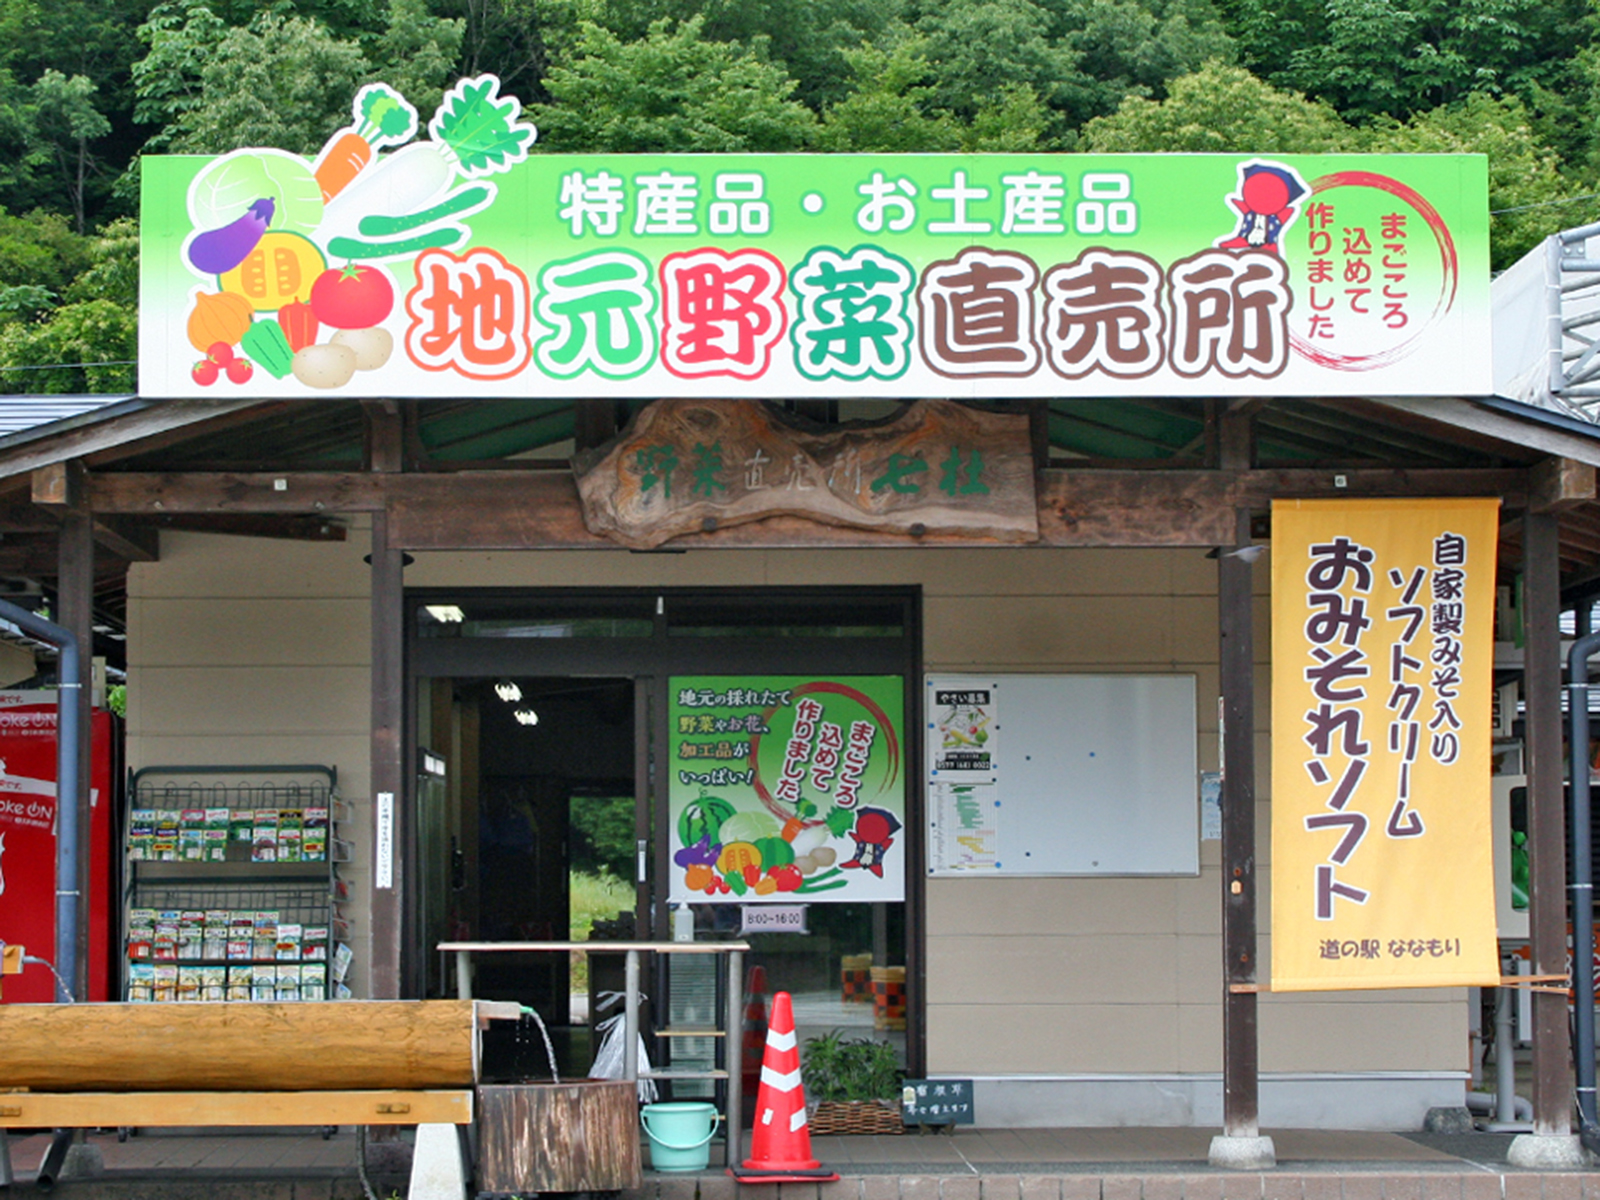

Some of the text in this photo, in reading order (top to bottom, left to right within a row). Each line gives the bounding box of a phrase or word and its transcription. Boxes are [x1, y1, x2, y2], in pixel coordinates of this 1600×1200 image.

[558, 170, 1138, 236] 特産品・お土産品
[416, 254, 1282, 374] 地元野菜直売所
[1305, 202, 1335, 339] 作りました
[1343, 227, 1372, 314] 込めて
[1381, 212, 1409, 329] まごころ
[1430, 533, 1465, 765] 自家製みそ入り
[678, 689, 791, 706] 地元の採れたて
[1304, 537, 1374, 920] おみそれソフト
[1387, 567, 1426, 838] ソフトクリーム
[679, 741, 750, 758] 加工品が
[776, 699, 822, 800] 作りました
[811, 724, 842, 790] 込めて
[834, 721, 874, 807] まごころ
[27, 801, 53, 820] ON
[1320, 938, 1460, 960] 道の駅 ななもり
